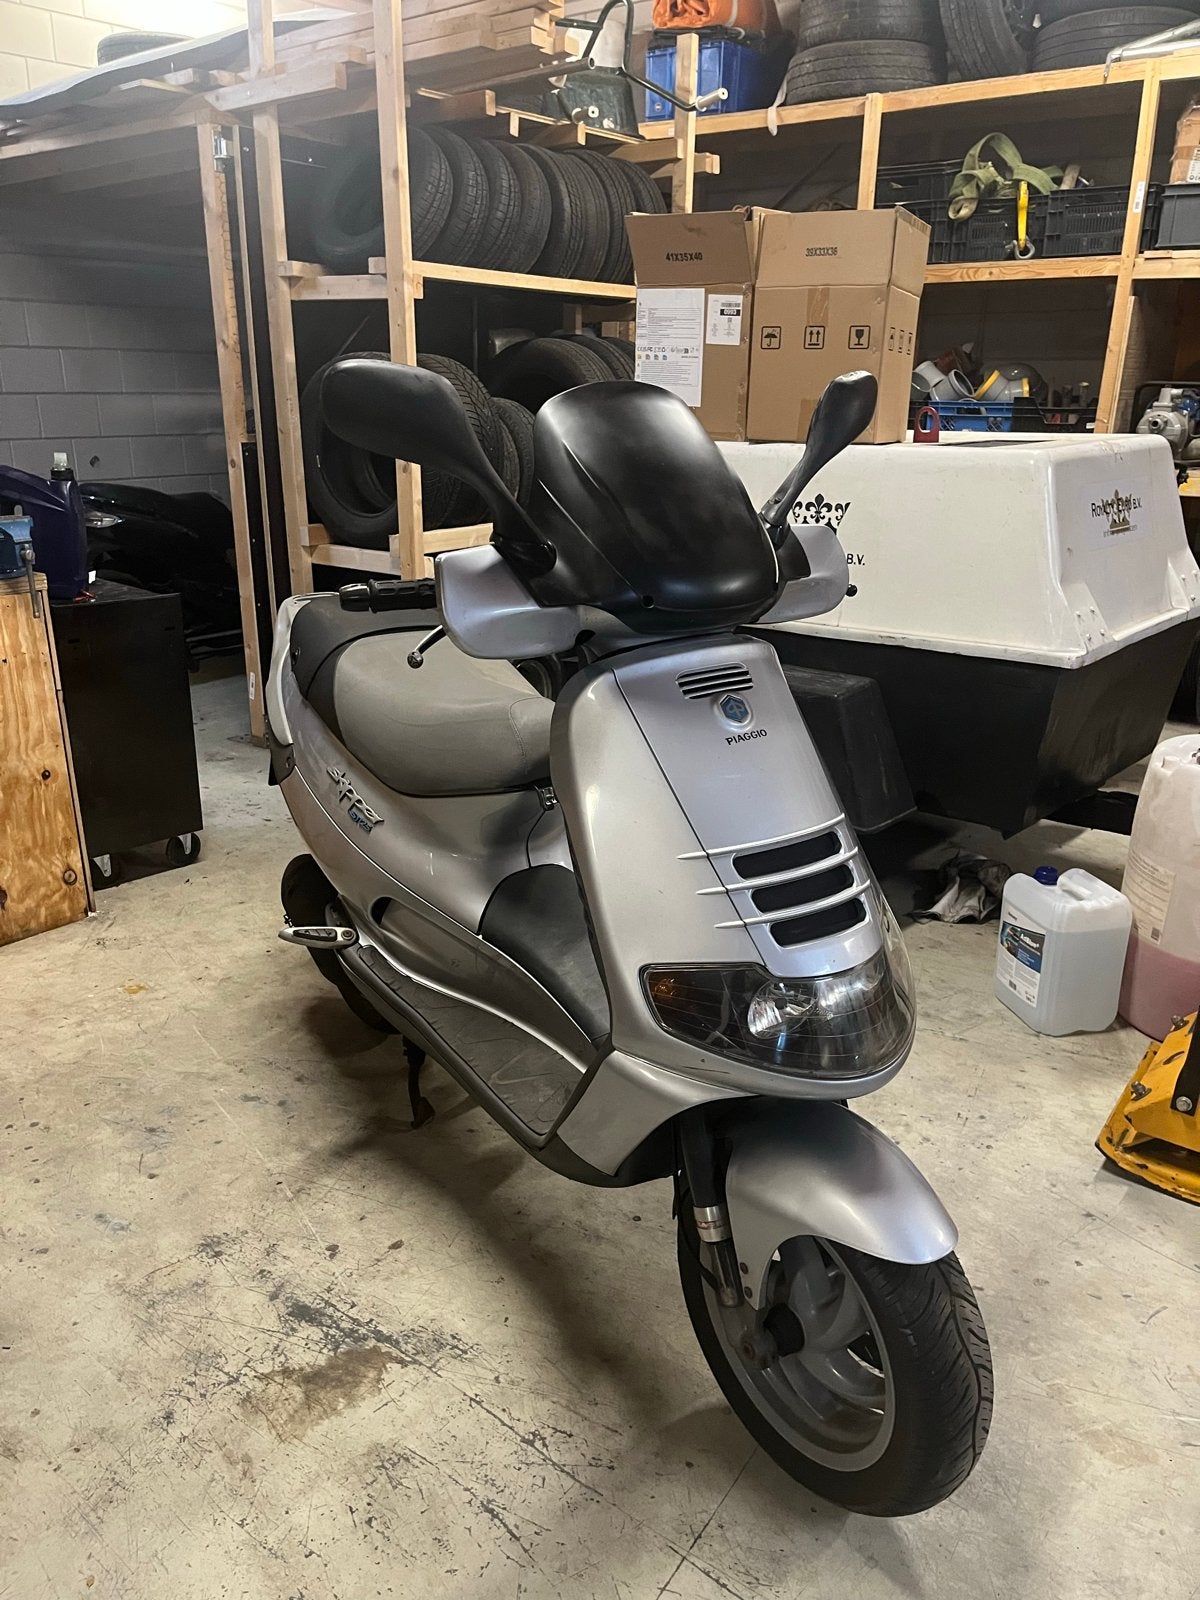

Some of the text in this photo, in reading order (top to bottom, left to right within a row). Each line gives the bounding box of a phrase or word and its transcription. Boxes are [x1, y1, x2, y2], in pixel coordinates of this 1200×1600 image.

[665, 250, 703, 262] 41X35X40
[846, 553, 865, 566] B.V.
[725, 729, 767, 746] PIAGGIO
